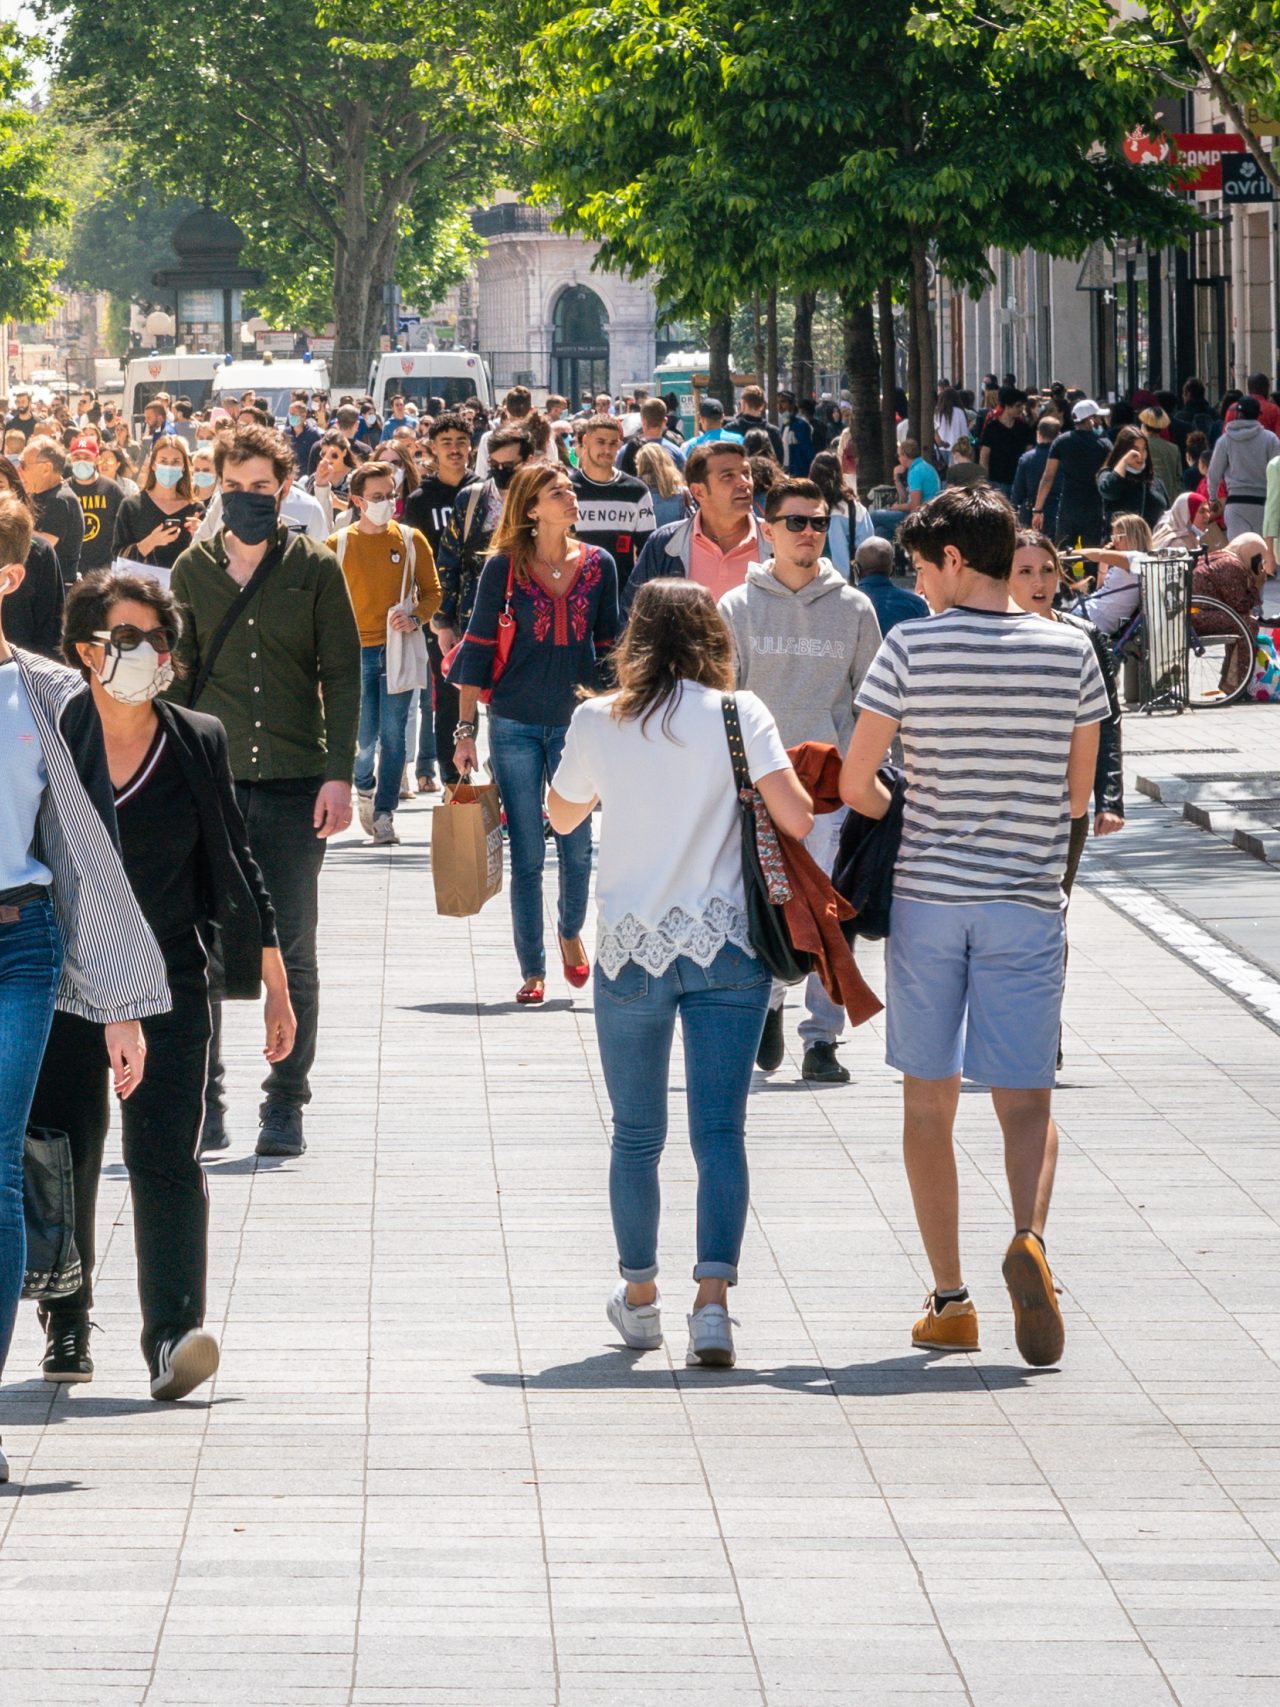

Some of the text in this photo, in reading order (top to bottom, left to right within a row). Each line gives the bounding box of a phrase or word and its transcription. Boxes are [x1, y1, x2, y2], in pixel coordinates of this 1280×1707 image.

[1177, 150, 1239, 170] CAMP
[1225, 176, 1270, 195] avril
[77, 495, 107, 510] VANA
[579, 510, 635, 523] VENCHY
